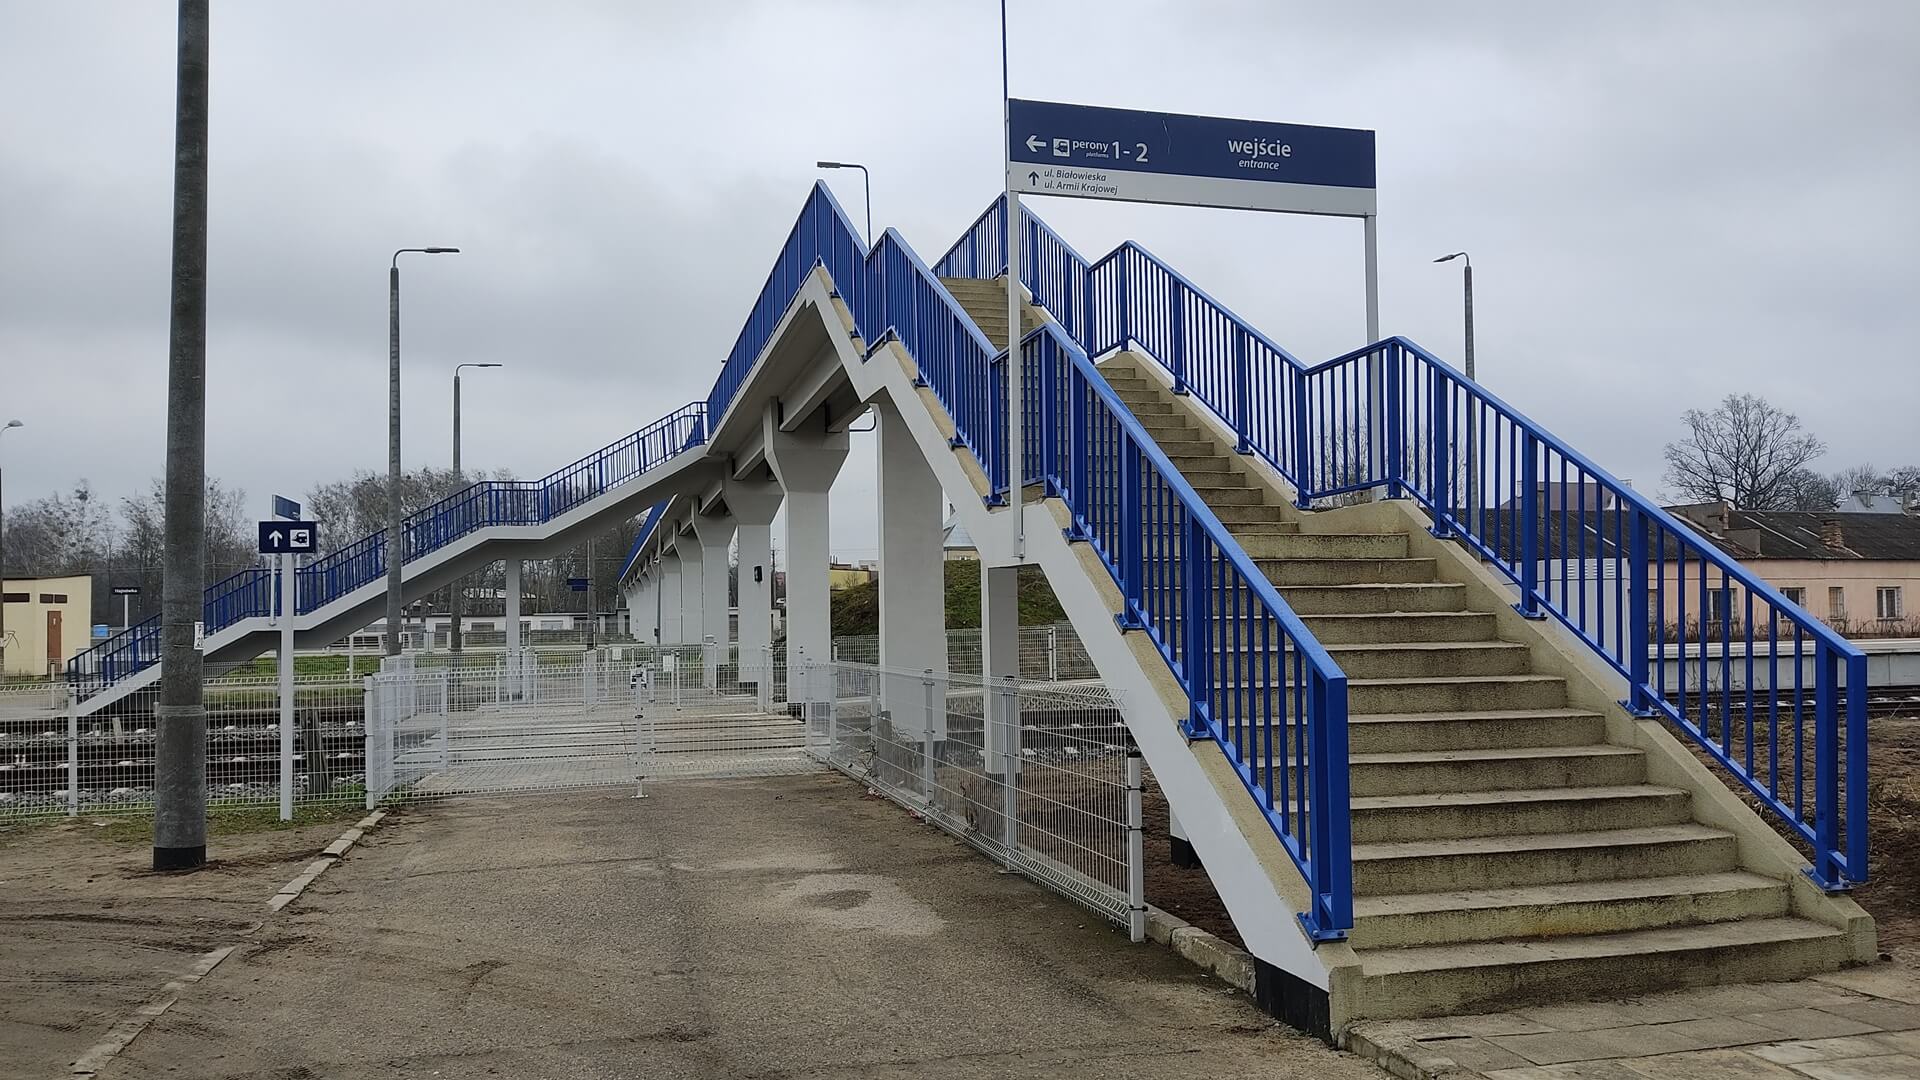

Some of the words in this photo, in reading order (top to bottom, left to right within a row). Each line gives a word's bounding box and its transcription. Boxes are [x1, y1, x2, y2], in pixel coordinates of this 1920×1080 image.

[1072, 140, 1109, 153] perony
[1228, 138, 1291, 158] wejście
[1239, 159, 1279, 170] entrance
[1044, 169, 1055, 178] ul.
[1056, 169, 1107, 182] Białowieska
[1044, 180, 1055, 189] ul.
[1056, 181, 1080, 191] Armii
[1081, 183, 1118, 195] Krajowej
